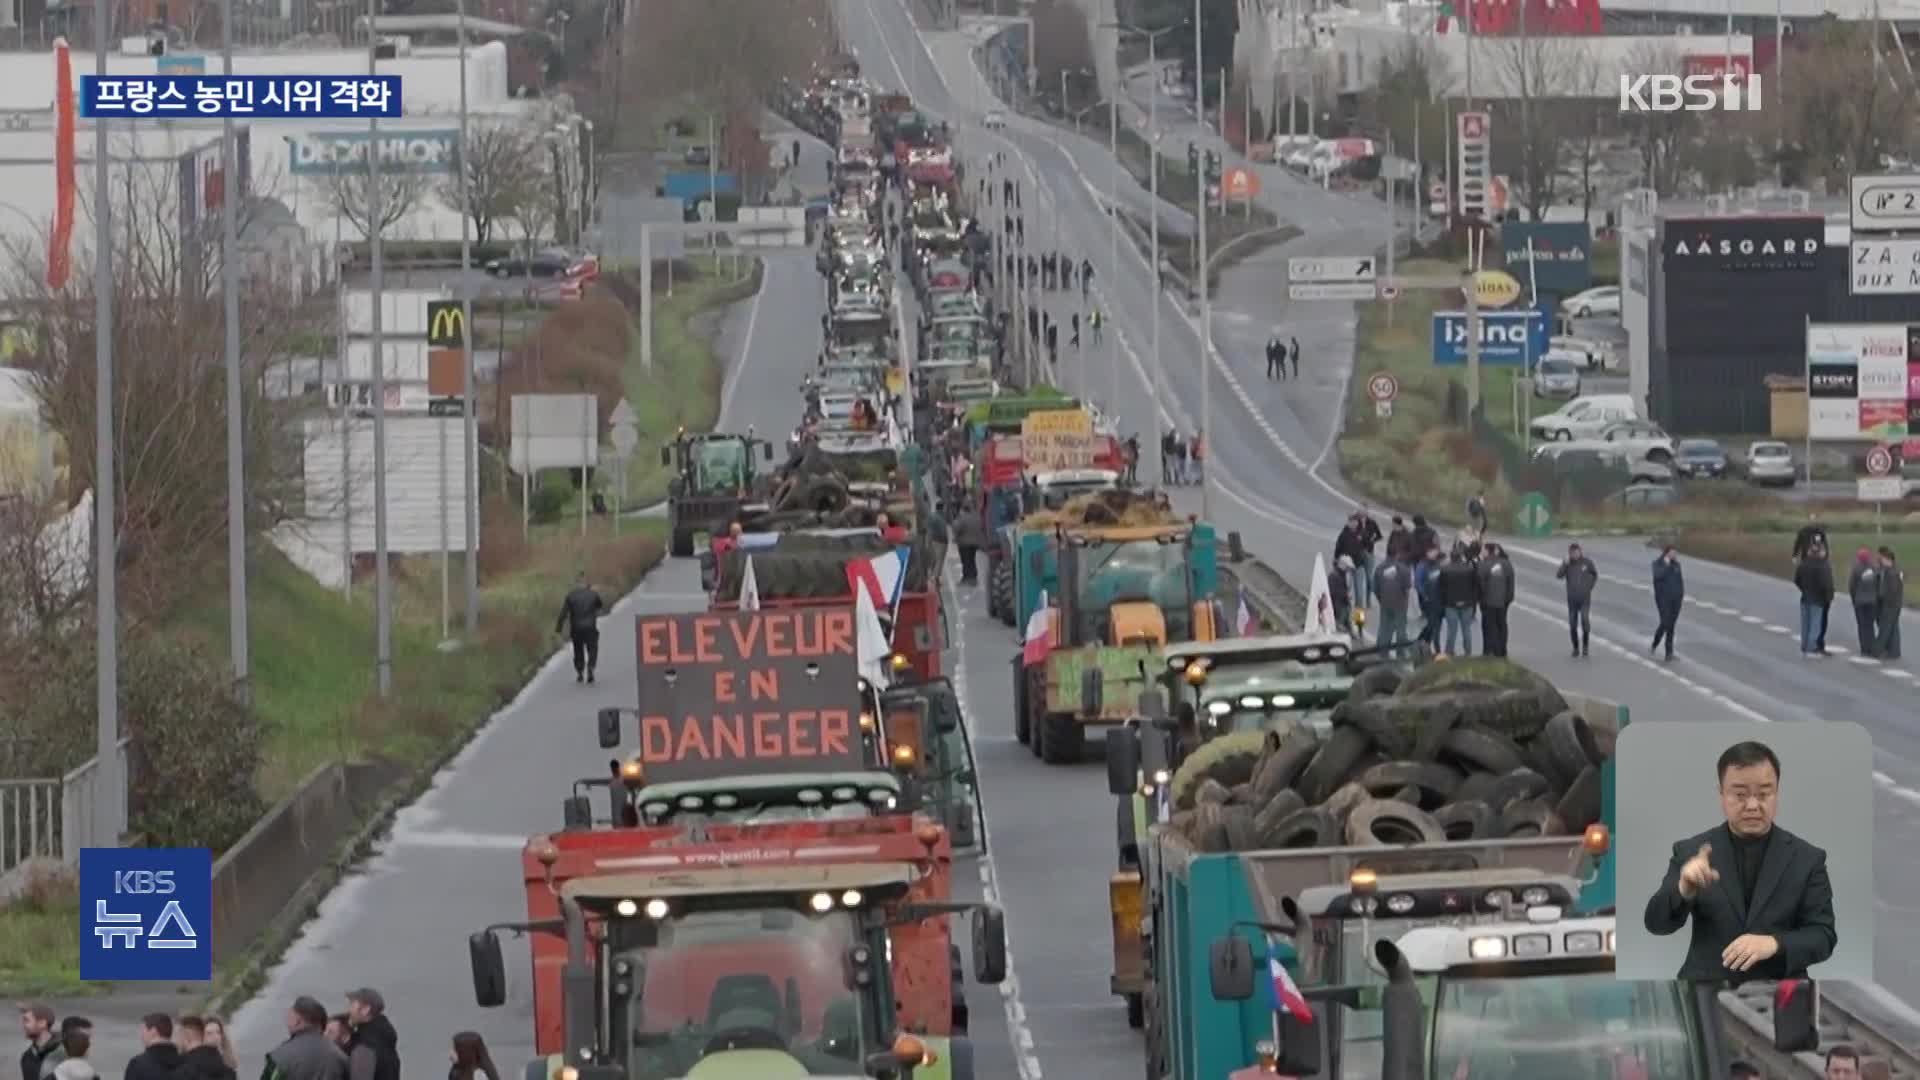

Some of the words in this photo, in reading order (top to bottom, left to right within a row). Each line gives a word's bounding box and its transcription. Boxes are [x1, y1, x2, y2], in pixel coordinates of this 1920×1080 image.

[296, 138, 452, 162] DECAHLON
[1857, 273, 1893, 287] aux
[641, 612, 853, 664] ELEVEUR
[715, 668, 779, 703] EN
[641, 709, 850, 763] DANGER
